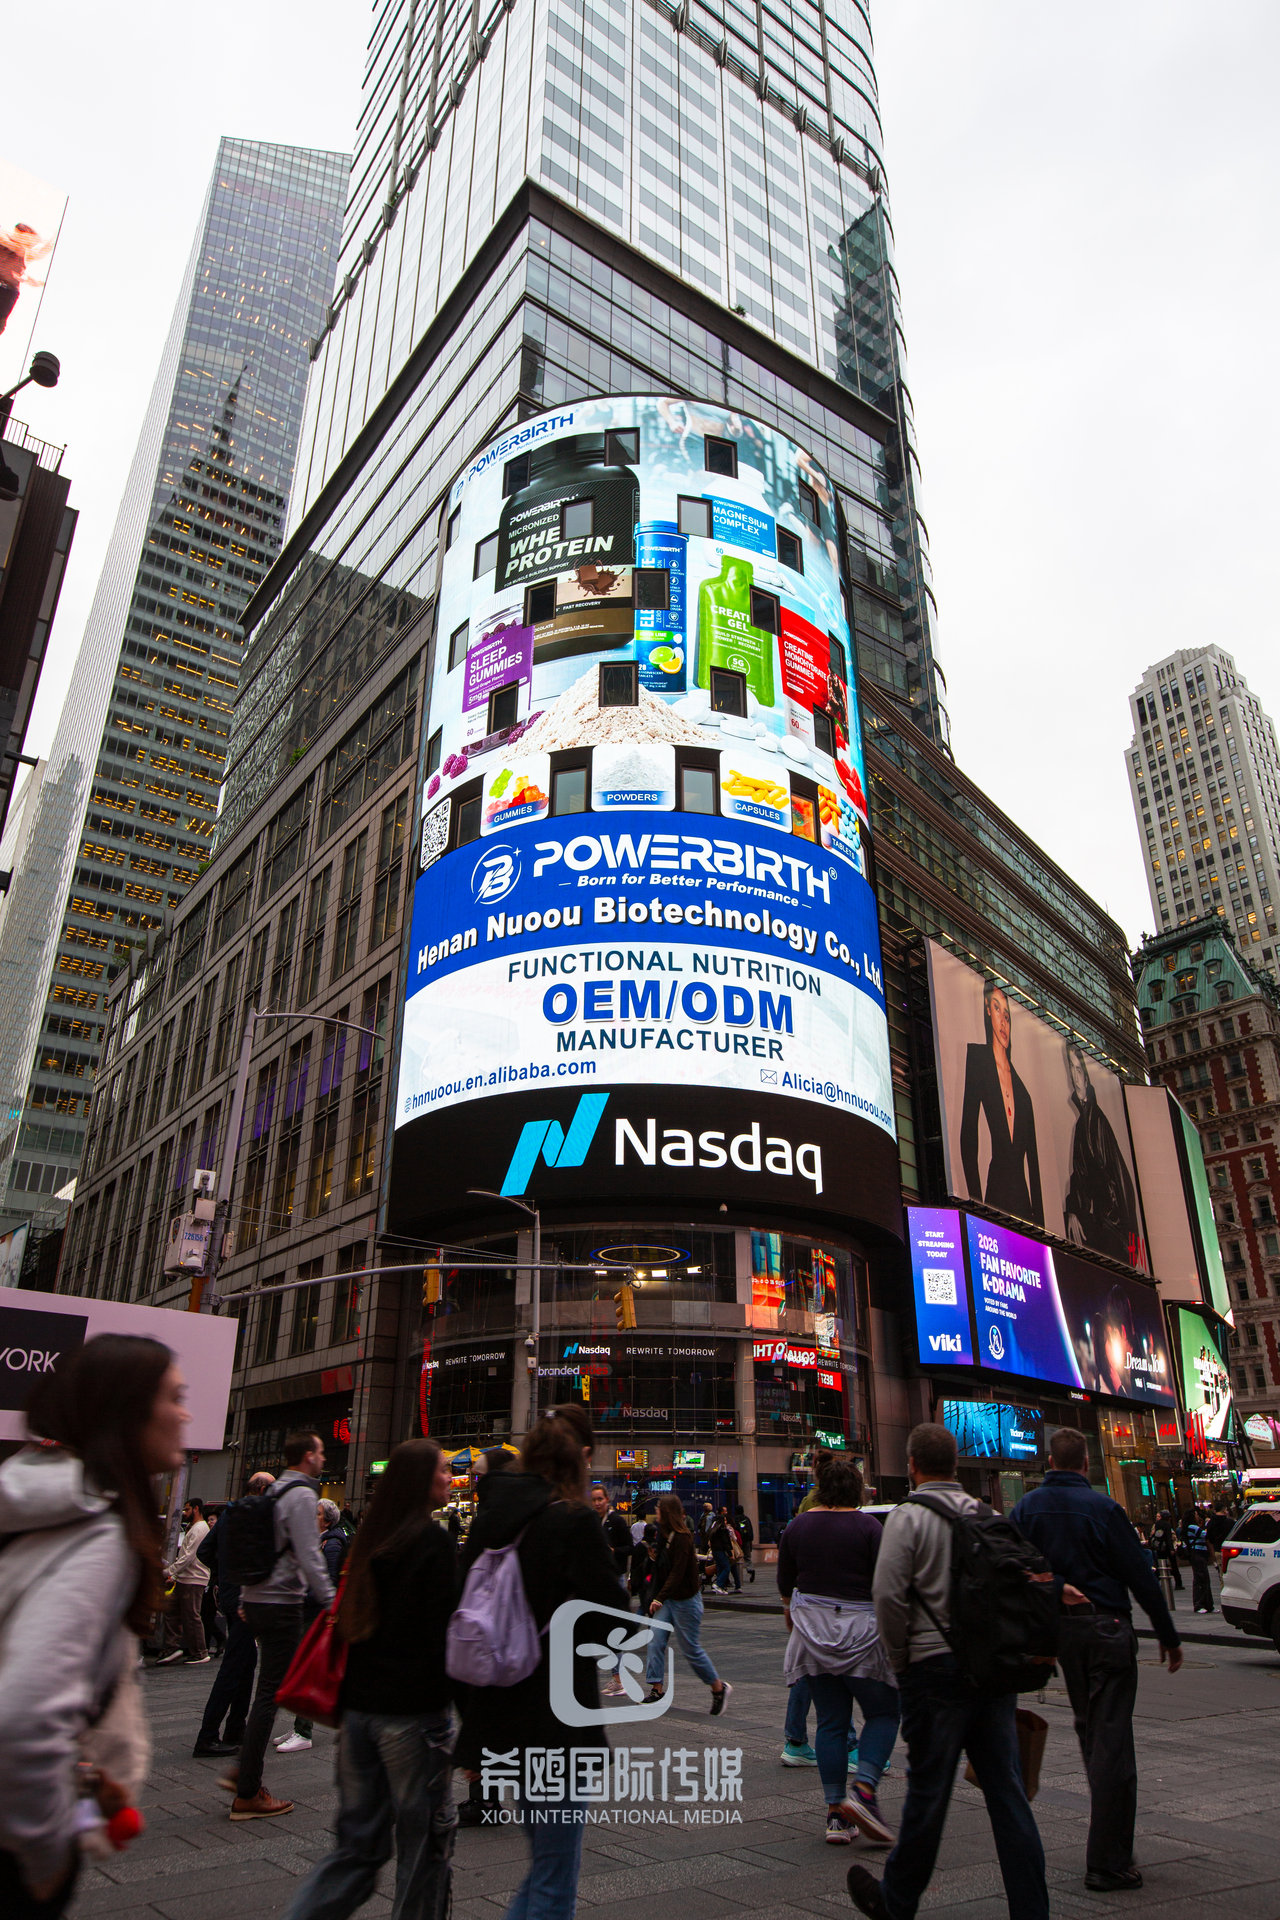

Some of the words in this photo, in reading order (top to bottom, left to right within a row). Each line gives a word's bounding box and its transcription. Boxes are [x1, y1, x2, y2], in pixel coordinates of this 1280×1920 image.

[468, 413, 574, 481] POWERBIRTH
[508, 513, 560, 540] MICRONIZED
[713, 506, 768, 531] MAGNESIUM
[713, 515, 760, 536] COMPLEX
[510, 526, 560, 559] WHE
[505, 535, 614, 579] PROTEIN
[575, 600, 602, 608] RECOVERY
[711, 605, 750, 623] CREATI
[727, 618, 749, 632] GEL
[714, 630, 731, 638] BUILD
[731, 634, 756, 646] STRENGTH
[470, 645, 507, 674] SLEEP
[732, 658, 745, 667] 5G
[784, 641, 814, 664] CREATINE
[469, 651, 523, 686] GUMMIES
[784, 649, 828, 681] MONOHYDRATE
[785, 658, 815, 680] GUMMIES
[607, 793, 658, 802] POWDERS
[493, 804, 533, 824] GUMMIES
[735, 801, 781, 821] CAPSULES
[831, 837, 855, 861] TABLETS
[577, 875, 616, 887] Born
[621, 873, 646, 886] for
[649, 873, 703, 888] Better
[706, 877, 799, 908] Performance
[416, 927, 478, 975] Henan
[486, 905, 583, 942] Nuoou
[593, 896, 818, 956] Biotechnology
[824, 930, 861, 977] Co.,
[863, 952, 884, 995] Ltd.
[508, 950, 683, 983] FUNCTIONAL
[692, 952, 822, 997] NUTRITION
[542, 979, 795, 1036] OEM/ODM
[556, 1028, 784, 1061] MANUFACTURER
[411, 1060, 597, 1110] hnnuoou.en.alibaba.com
[781, 1071, 893, 1128] Alicia@hnnuoou.com
[615, 1118, 824, 1195] Nasdaq
[917, 1240, 955, 1249] STREAMING
[924, 1230, 945, 1238] START
[977, 1233, 999, 1254] 2026
[926, 1250, 948, 1259] TODAY
[980, 1252, 1000, 1274] FAN
[1000, 1258, 1042, 1288] FAVORITE
[981, 1272, 1027, 1303] K-DRAMA
[579, 1345, 611, 1356] Nasdaq
[626, 1347, 664, 1355] REWRITE
[668, 1347, 716, 1356] TOMORROW
[928, 1333, 962, 1352] Viki
[445, 1356, 467, 1366] REWRITE
[469, 1352, 506, 1362] TOMORROW
[818, 1359, 839, 1369] REWRITE
[1124, 1352, 1147, 1371] Dream
[538, 1365, 609, 1376] brandedcities
[623, 1406, 668, 1421] Nasdaq
